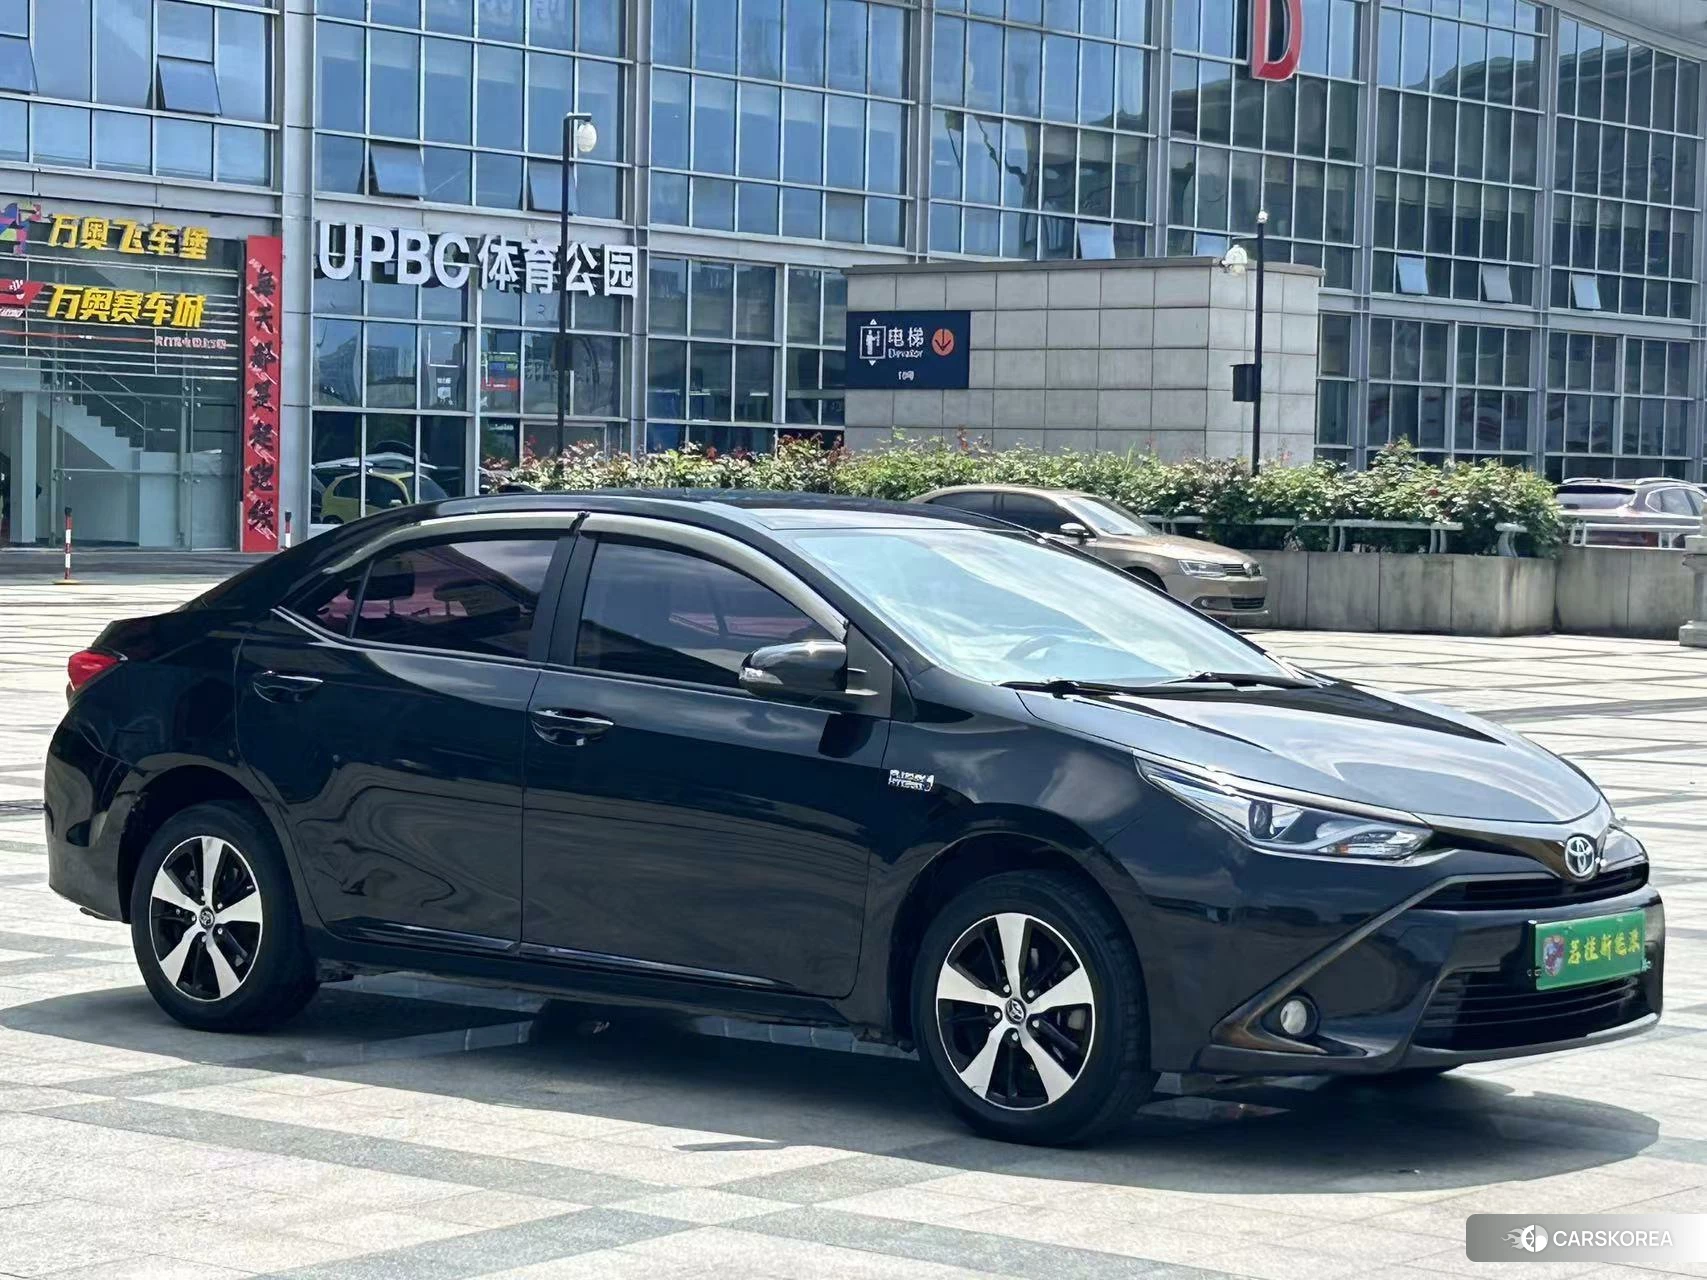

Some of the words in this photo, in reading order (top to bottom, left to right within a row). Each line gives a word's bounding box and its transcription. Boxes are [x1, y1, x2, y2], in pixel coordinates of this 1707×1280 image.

[48, 214, 209, 260] 万奥飞车堡
[47, 284, 207, 328] 万奥赛车城
[888, 326, 924, 347] 电梯
